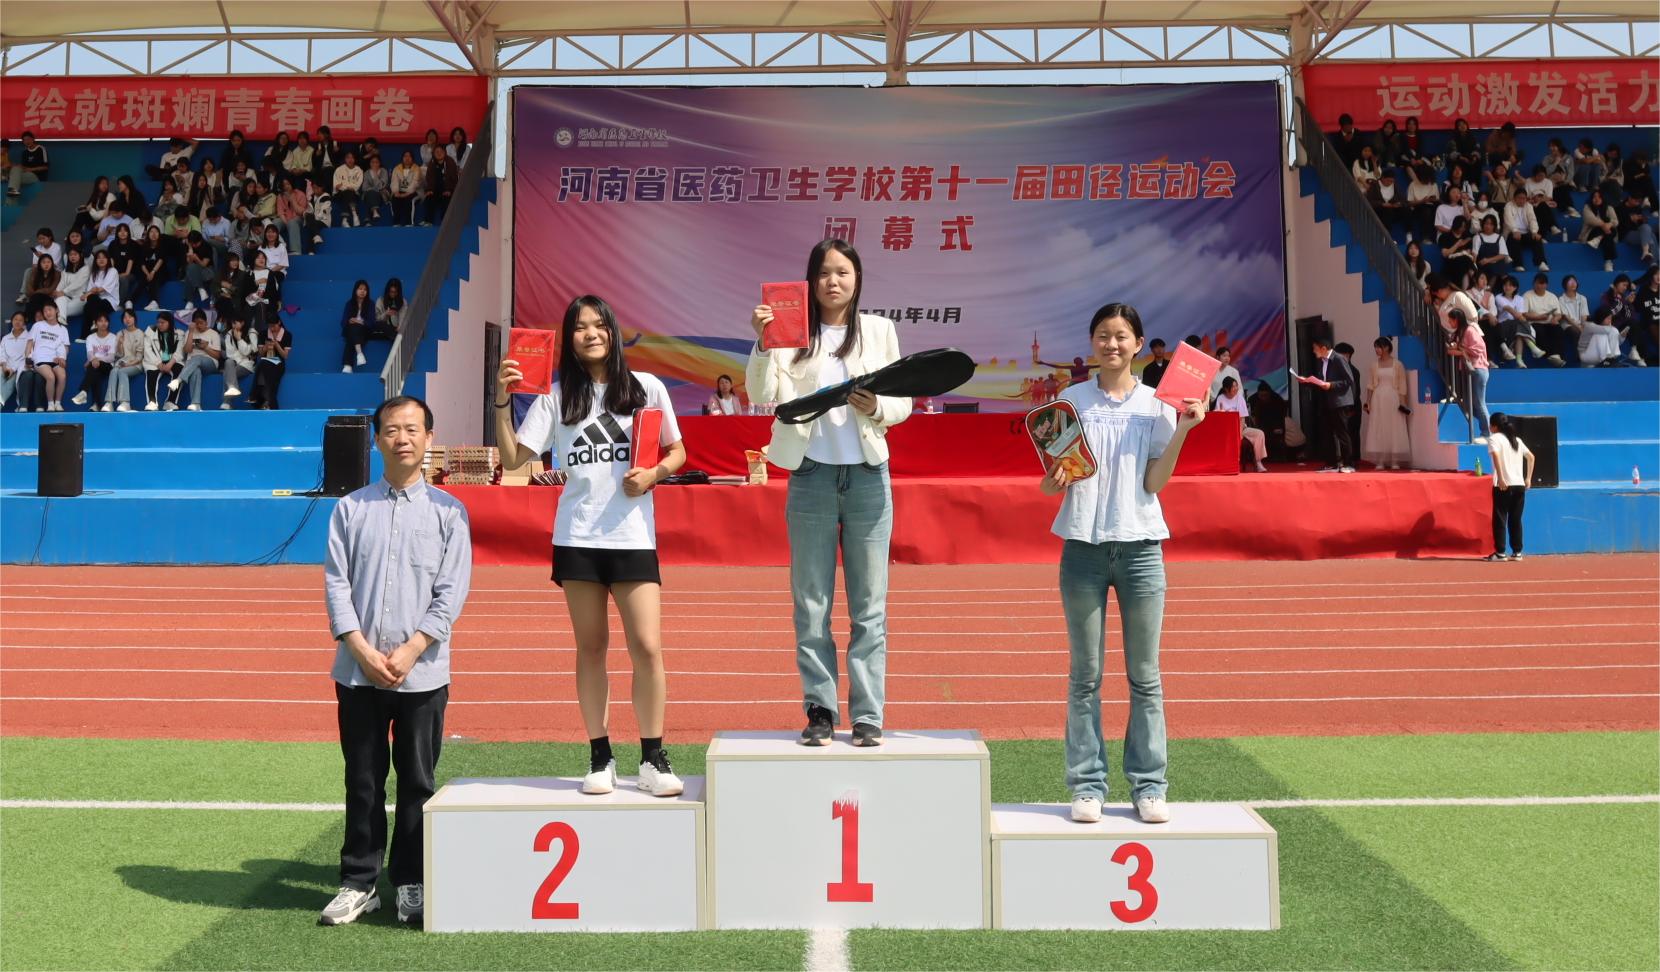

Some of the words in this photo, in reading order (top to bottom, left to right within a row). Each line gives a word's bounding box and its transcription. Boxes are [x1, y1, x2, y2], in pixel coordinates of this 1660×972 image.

[23, 87, 415, 133] 绘就斑斓青春画卷
[1377, 70, 1658, 117] 运动激发活力
[557, 160, 1237, 203] 河南省医药卫生学校第十一届田径运动会
[824, 215, 975, 251] 闭幕式
[568, 443, 630, 467] adida
[532, 821, 580, 919] 2
[827, 798, 873, 902] 1
[1110, 842, 1159, 923] 3
